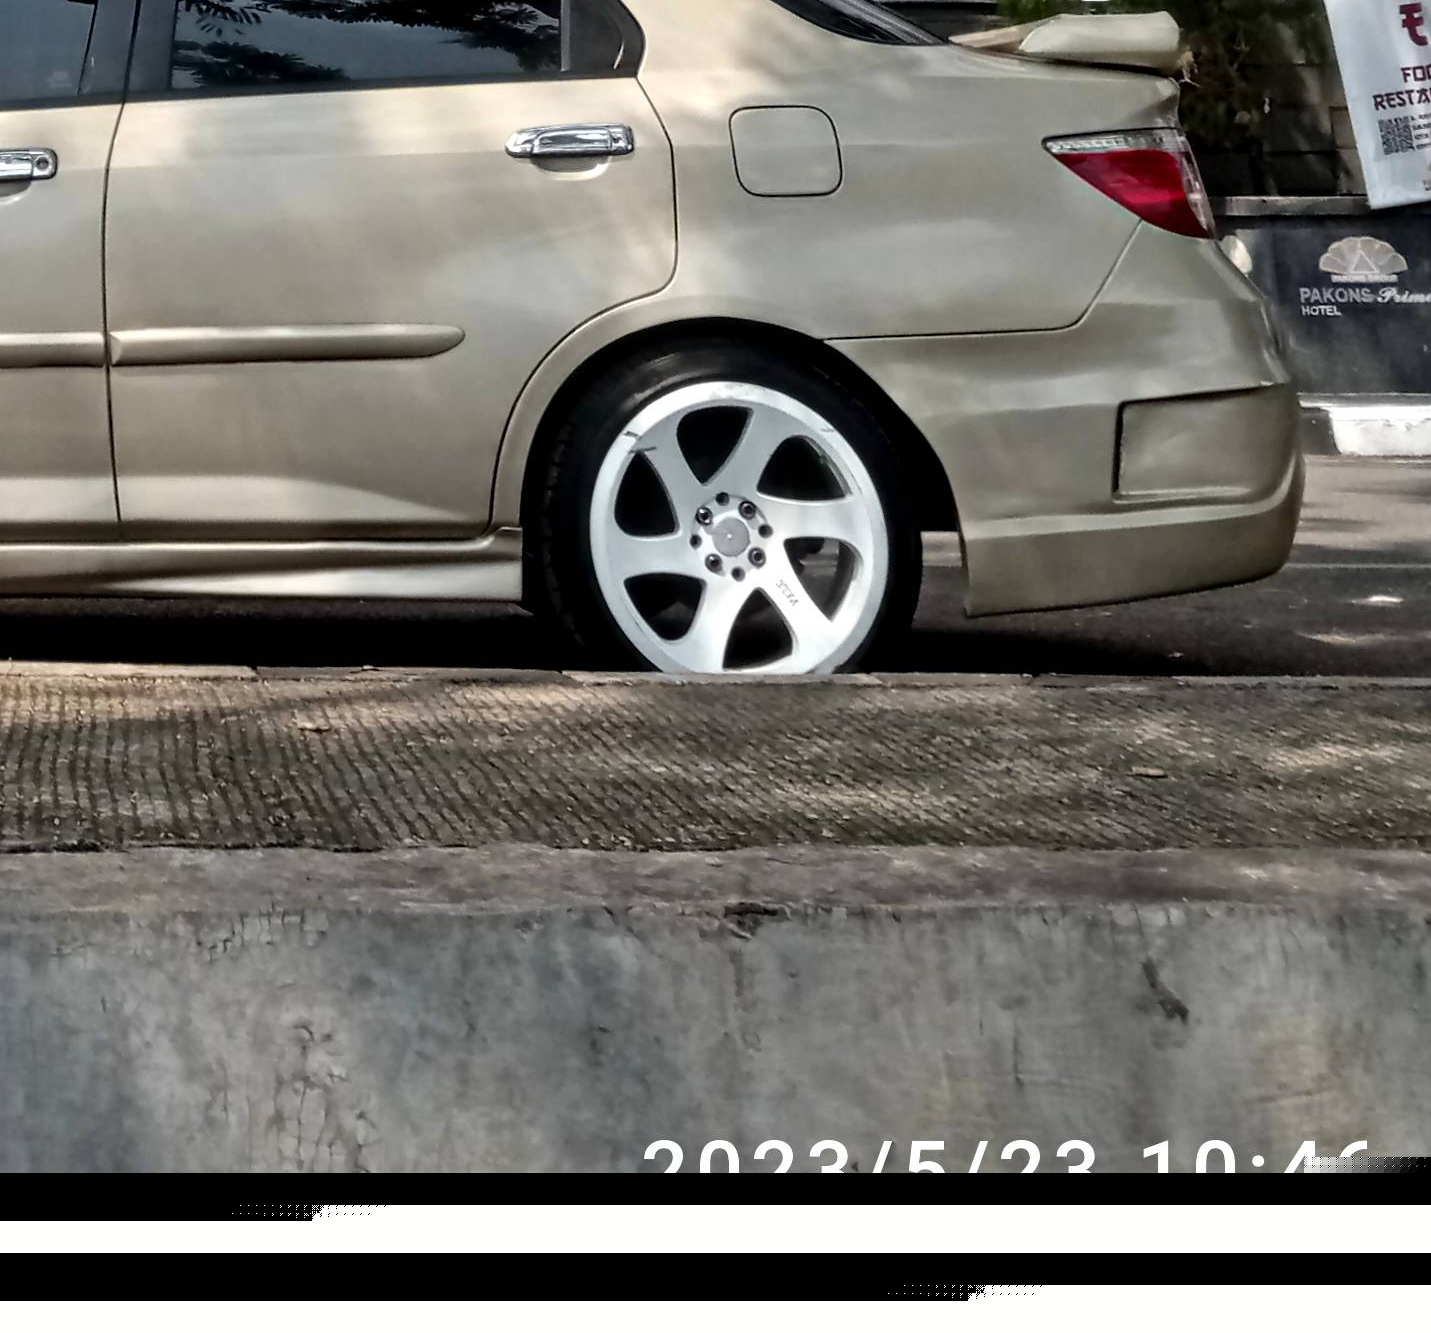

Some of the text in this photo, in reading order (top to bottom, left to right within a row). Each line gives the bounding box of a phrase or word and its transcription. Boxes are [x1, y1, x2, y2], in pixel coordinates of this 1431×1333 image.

[1372, 87, 1431, 111] RESTA
[1299, 287, 1374, 303] PAKONS
[1302, 305, 1343, 316] HOTEL
